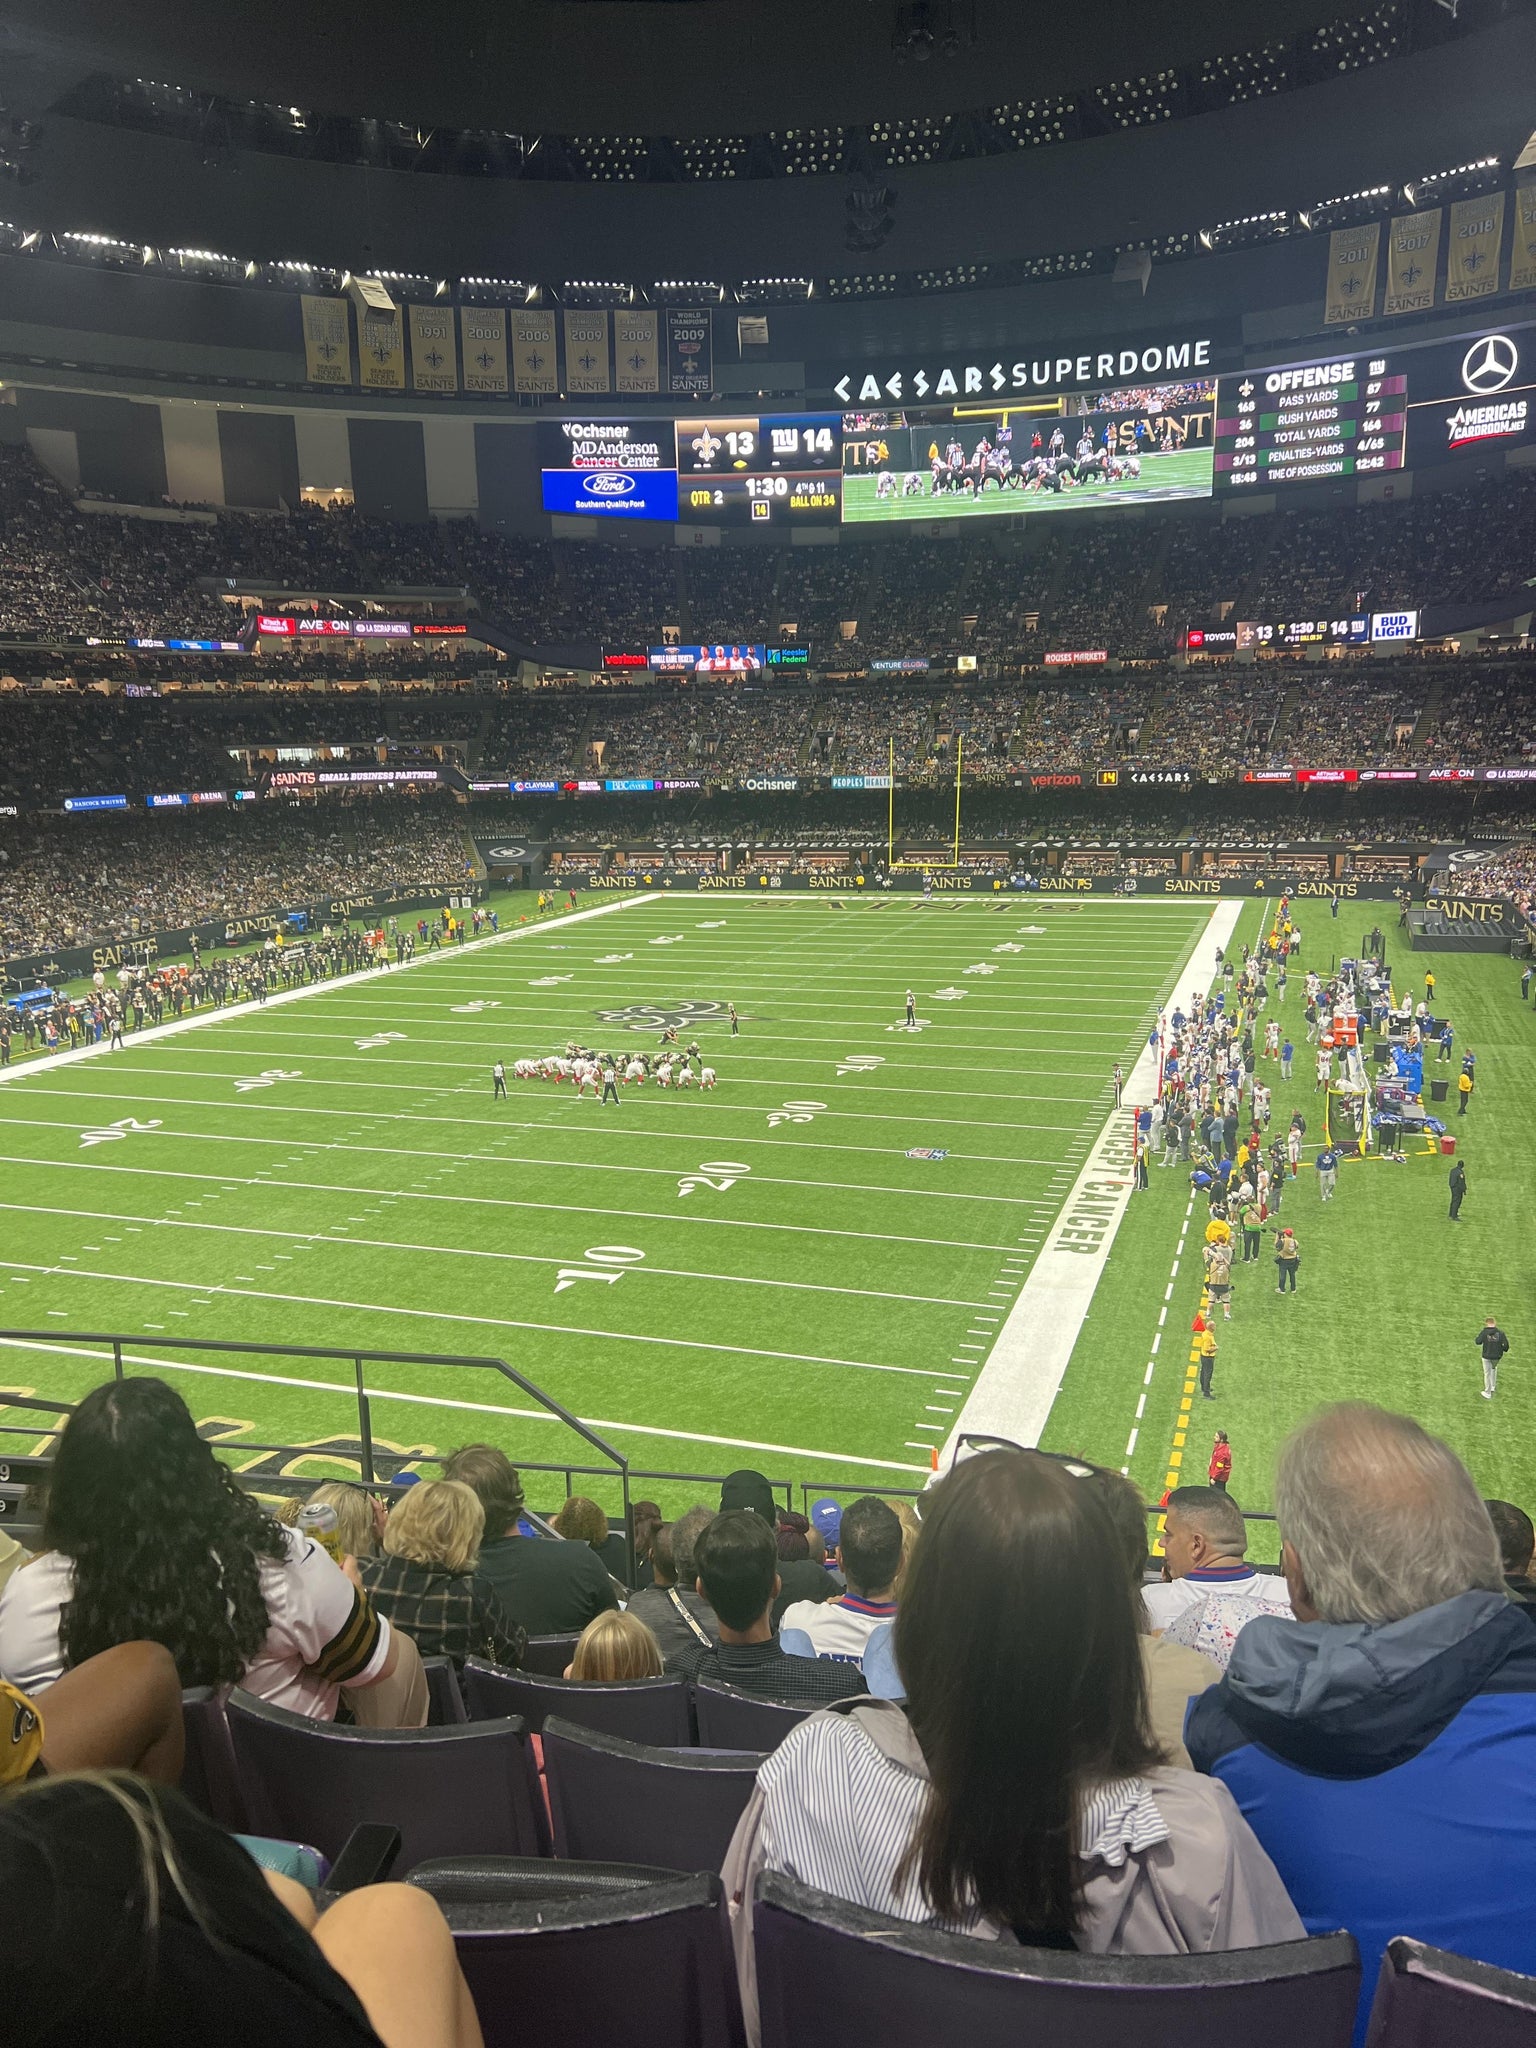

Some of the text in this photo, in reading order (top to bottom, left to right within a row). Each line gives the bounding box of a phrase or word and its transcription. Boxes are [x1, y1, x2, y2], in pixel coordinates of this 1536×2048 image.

[1458, 219, 1494, 238] 2018
[1398, 235, 1431, 252] 2017
[1338, 248, 1368, 265] 2011
[1449, 280, 1495, 300] SAINTS
[1387, 295, 1430, 311] SAINTS
[1327, 306, 1370, 322] SAINTS
[418, 326, 447, 339] 1991
[468, 327, 500, 340] 2000
[518, 330, 550, 341] 2006
[571, 330, 602, 341] 2009
[621, 330, 652, 342] 2009
[673, 329, 705, 341] 2009
[834, 340, 1211, 402] CAESARS SUPERDOME
[1265, 361, 1355, 393] OFFENSE
[417, 378, 455, 390] SAINTS
[467, 380, 505, 390] SAINTS
[518, 381, 555, 391] SAINTS
[570, 381, 607, 391] SAINTS
[619, 380, 656, 391] SAINTS
[672, 380, 709, 390] SAINTS
[1279, 396, 1304, 408] PASS
[1305, 389, 1339, 404] YARDS
[1366, 383, 1381, 395] 87
[1239, 401, 1381, 430] 36 RUSH YARDS 77
[1453, 401, 1528, 426] AMERICAS
[571, 423, 629, 438] Ochsner
[1274, 430, 1306, 444] TOTAL
[1308, 425, 1341, 440] YARDS
[1362, 420, 1382, 432] 164
[572, 440, 659, 454] MD Anderson
[725, 431, 754, 456] 13
[802, 428, 834, 453] 14
[572, 454, 660, 468] Cancer Center
[1232, 454, 1257, 467] 3/13
[1268, 443, 1344, 462] PENALTIES-YARDS
[1268, 469, 1286, 480] TIME
[1286, 467, 1297, 478] OF
[1297, 461, 1343, 477] POSSESSION
[1355, 456, 1385, 470] 12:42
[592, 476, 626, 491] Ford
[745, 477, 788, 497] 1:30
[795, 482, 808, 495] 4TH
[816, 482, 825, 493] 11
[575, 500, 645, 509] Southern Quality Ford
[690, 490, 724, 506] QTR 2
[790, 494, 836, 508] BALL ON 34
[755, 504, 766, 515] 14
[299, 620, 350, 630] AVEXON
[1380, 615, 1408, 627] BUD
[365, 624, 373, 632] LA
[374, 624, 390, 633] SCRAP
[1256, 625, 1273, 640] 13
[1289, 621, 1314, 634] 1:30
[1330, 620, 1348, 635] 14
[1375, 626, 1412, 638] LIGHT
[1203, 632, 1237, 642] TOYOTA
[604, 653, 646, 665] verizon
[902, 660, 929, 668] GLOBAL
[1045, 652, 1106, 663] ROUSES MARKETS
[276, 771, 438, 785] SAINTS SMALL BUSINESS PARTNERS
[908, 775, 938, 784] SAINTS
[976, 774, 1007, 782] SAINTS
[1030, 774, 1081, 786] verizon
[1102, 772, 1116, 784] 14
[1130, 772, 1190, 783] CAESARS
[1201, 770, 1235, 779] SAINTS
[1429, 770, 1475, 778] AVEXON
[1498, 770, 1528, 778] LA SCRAP
[746, 778, 797, 790] Ochsner
[832, 778, 864, 788] PEOPLES
[590, 876, 637, 888] SAINTS
[699, 876, 746, 888] SAINTS
[808, 876, 854, 888] SAINTS
[930, 876, 972, 889] AINTS
[1040, 877, 1093, 890] SAINTS
[1164, 879, 1222, 893] SAINTS
[1298, 882, 1358, 896] SAINTS
[1425, 899, 1504, 923] SAINTS
[765, 1100, 829, 1123] 30
[676, 1161, 752, 1193] 20
[1053, 1181, 1125, 1255] CANCER
[555, 1245, 647, 1285] 10
